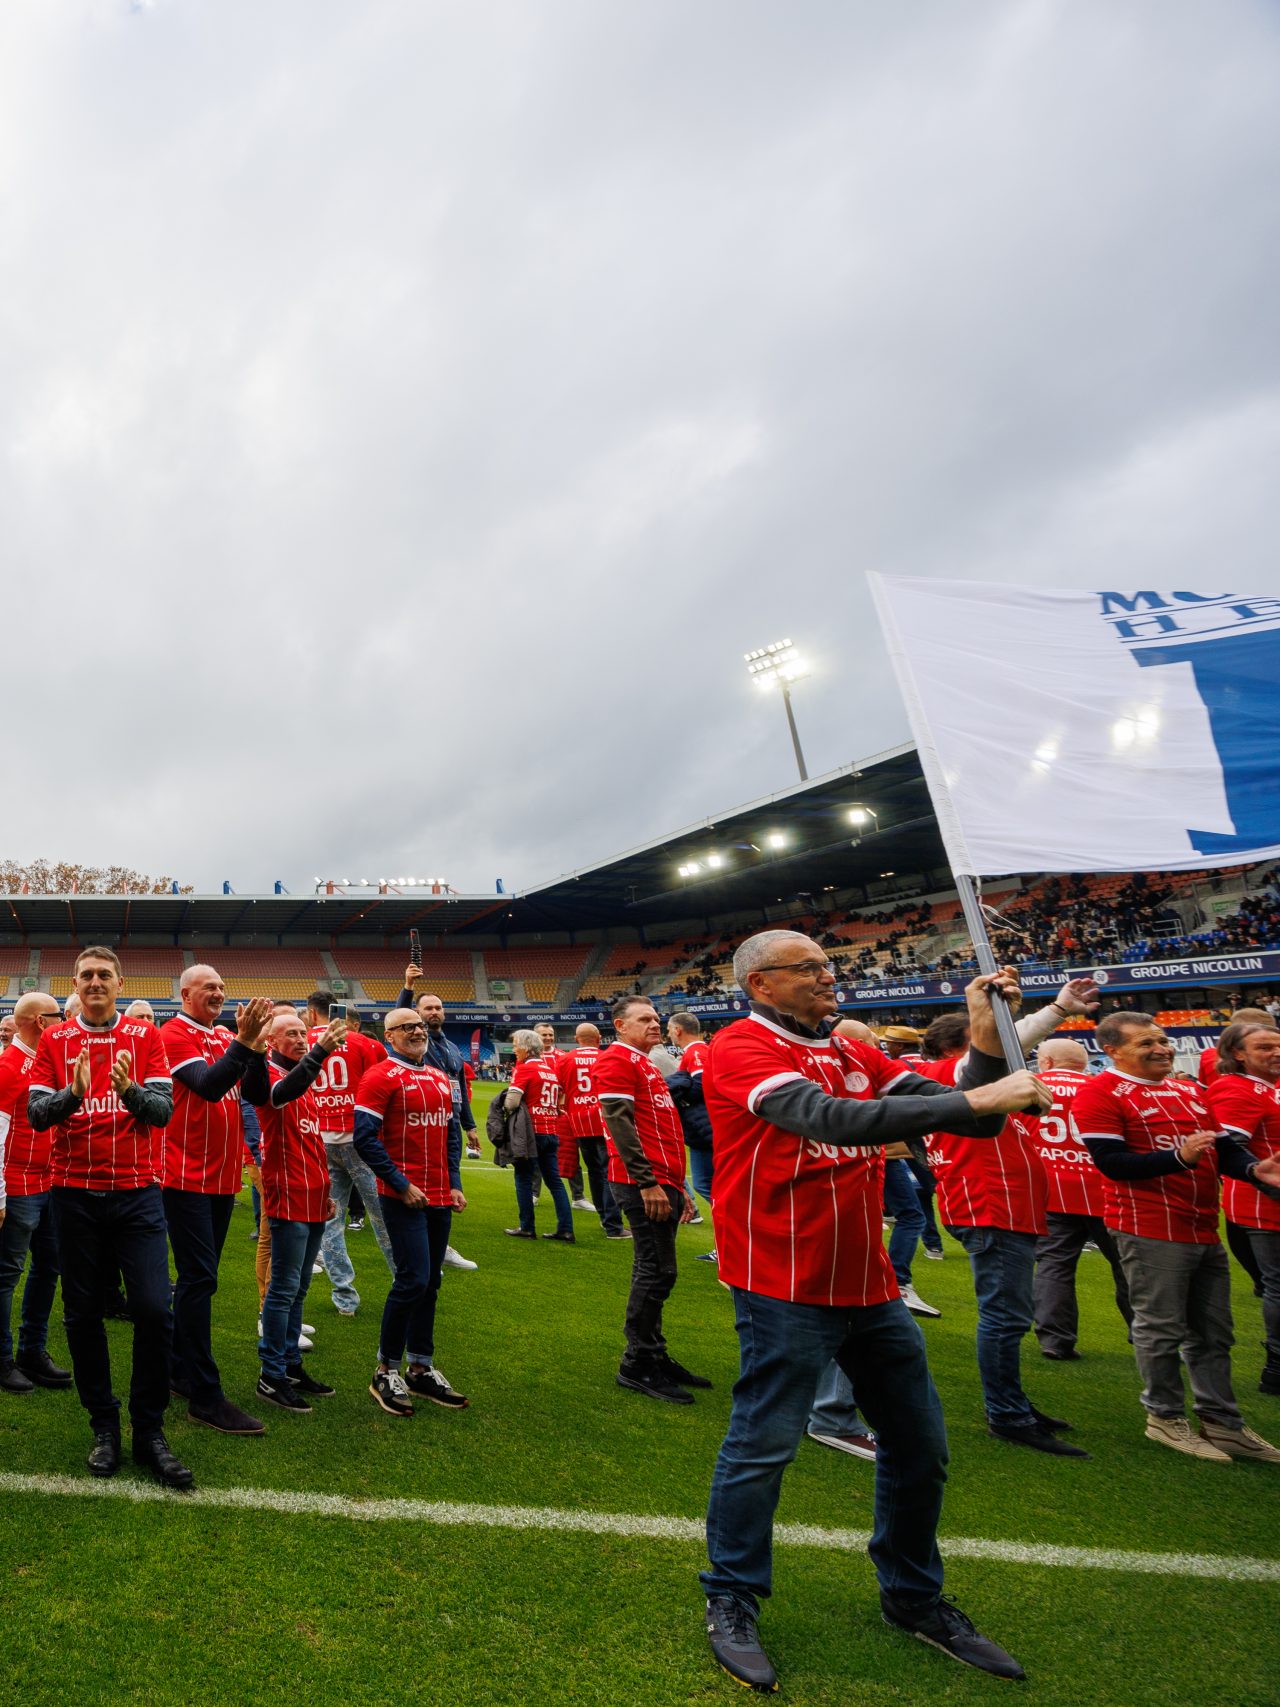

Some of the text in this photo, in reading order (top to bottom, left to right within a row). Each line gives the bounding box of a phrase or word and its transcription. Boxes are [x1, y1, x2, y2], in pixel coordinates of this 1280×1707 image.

[1130, 957, 1263, 978] GROUPE NICOLLIN
[1021, 973, 1070, 986] NICOLLIN
[855, 986, 925, 999] GROUPE NICOLLIN
[120, 1023, 148, 1038] EPI
[577, 1067, 592, 1093] 5
[540, 1081, 559, 1109] 50
